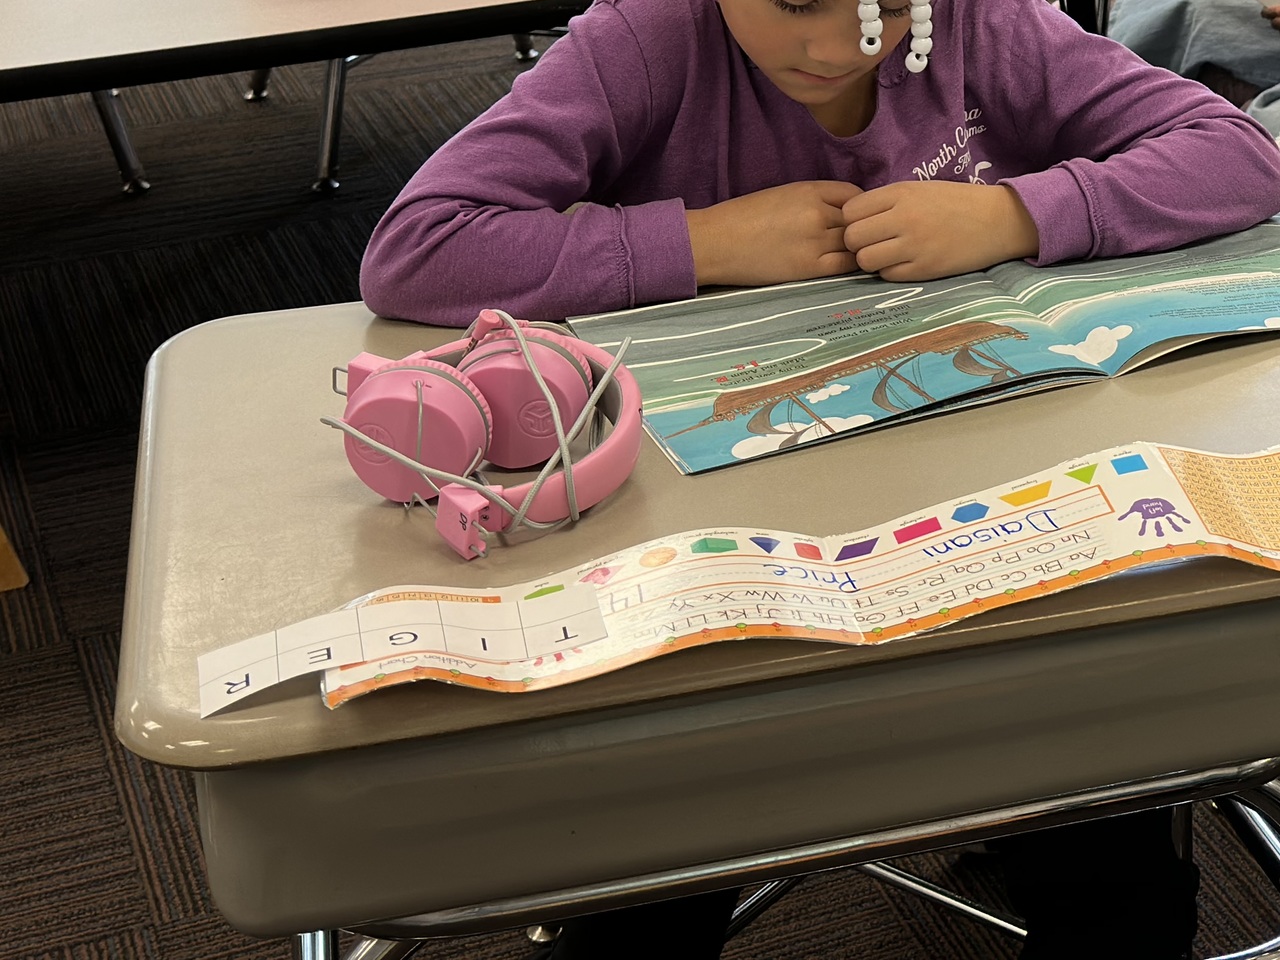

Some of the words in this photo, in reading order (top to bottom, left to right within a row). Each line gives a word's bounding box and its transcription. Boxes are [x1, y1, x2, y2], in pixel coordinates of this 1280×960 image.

[912, 143, 957, 181] North
[460, 512, 468, 531] DP
[1060, 529, 1091, 543] Nn
[1027, 542, 1056, 554] Oo
[1069, 547, 1097, 561] Aa
[992, 552, 1022, 564] Pp
[950, 562, 986, 574] Qq
[1033, 560, 1063, 574] Bb
[763, 563, 862, 594] Price
[917, 573, 946, 586] Rr
[1001, 570, 1027, 582] Cc
[885, 585, 910, 597] Ss
[965, 579, 994, 595] Dd
[608, 583, 644, 614] 14
[703, 591, 736, 602] Xx
[745, 590, 786, 602] Ww
[792, 593, 814, 605] Vv
[819, 597, 847, 609] Uu
[855, 596, 879, 608] Tt
[928, 590, 957, 604] Ee
[669, 598, 695, 611] Yy
[756, 603, 781, 618] Jj
[898, 602, 920, 616] Ff
[686, 613, 708, 627] Ll
[717, 609, 747, 620] Kk
[813, 612, 845, 625] Hh
[853, 612, 886, 624] Gg
[388, 631, 418, 645] G
[555, 626, 578, 643] T
[481, 637, 487, 651] I
[307, 646, 332, 665] E
[424, 655, 477, 668] Addition
[378, 656, 418, 670] Chart
[224, 673, 250, 695] R
